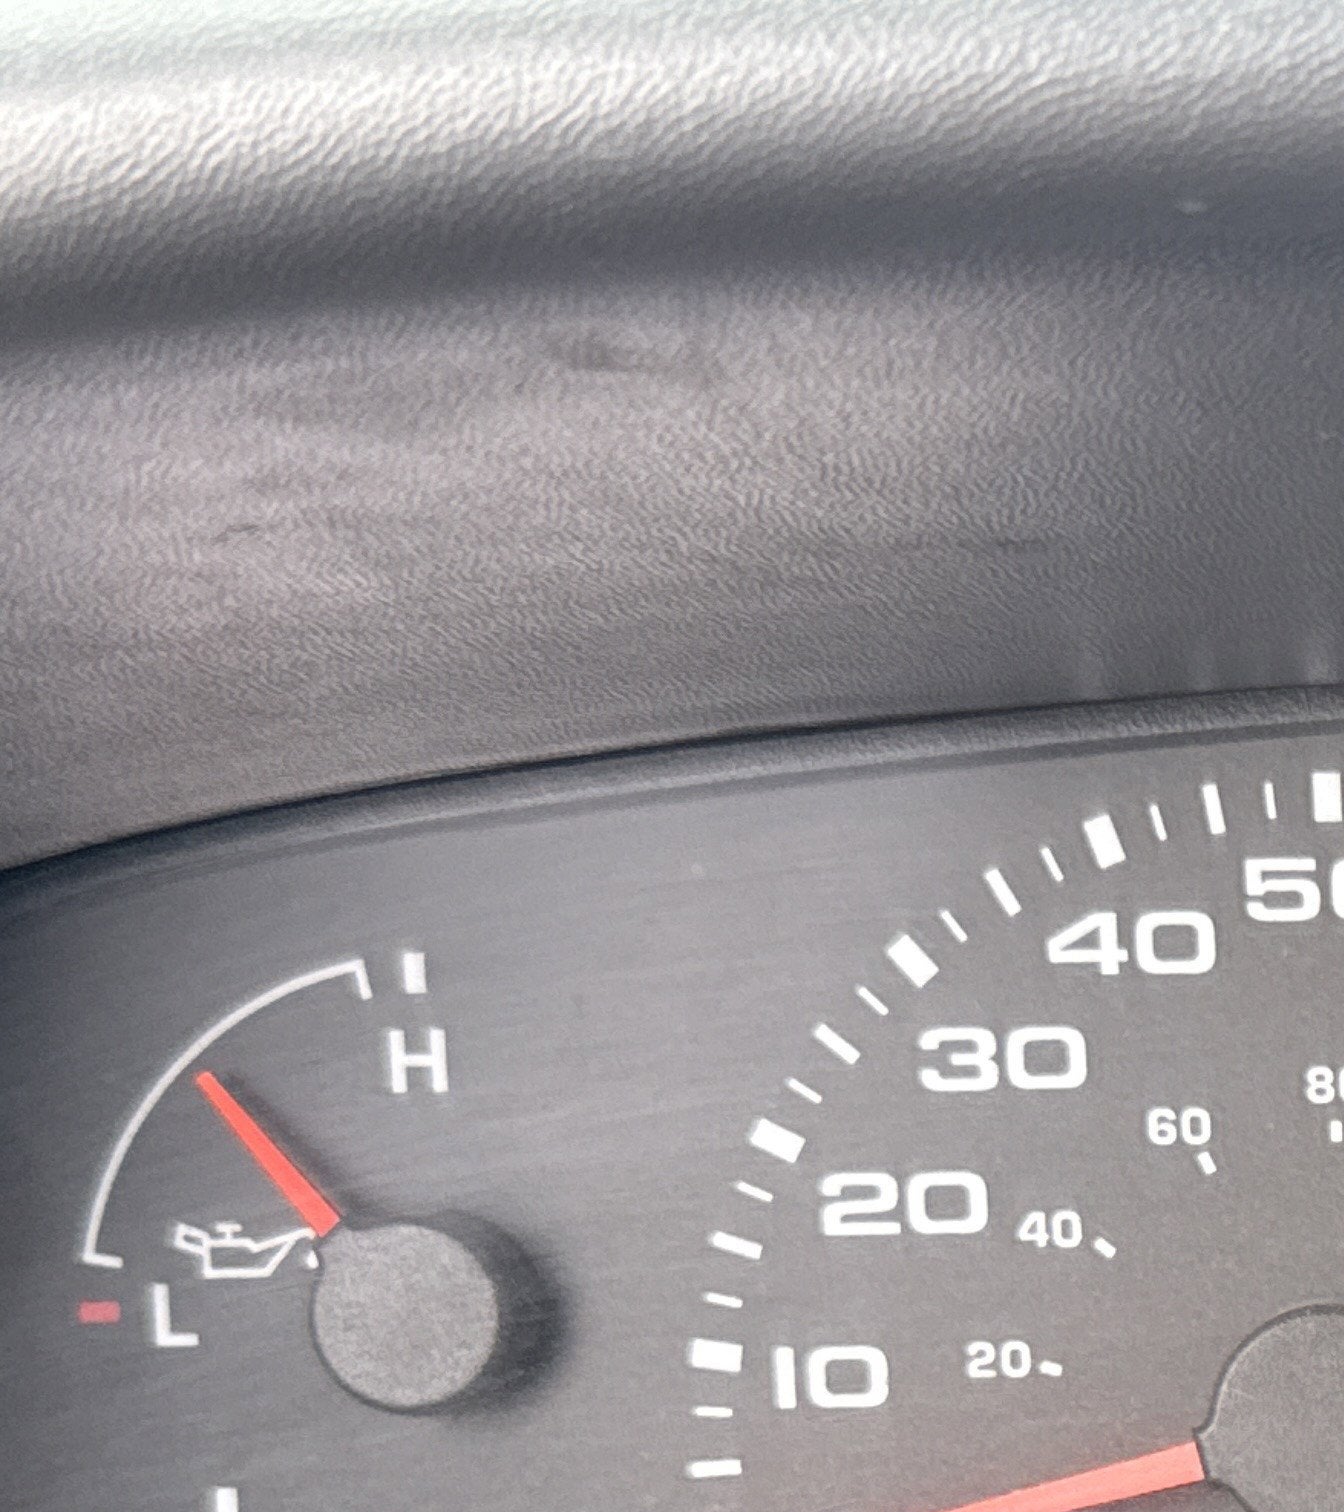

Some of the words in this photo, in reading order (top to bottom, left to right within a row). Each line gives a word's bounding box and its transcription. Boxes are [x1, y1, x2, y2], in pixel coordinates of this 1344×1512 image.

[1046, 910, 1216, 976] 40
[386, 1027, 449, 1094] H
[917, 1025, 1087, 1092] 30
[1147, 1106, 1212, 1146] 60
[818, 1170, 989, 1237] 20
[1016, 1209, 1083, 1249] 40
[151, 1283, 199, 1348] L
[772, 1344, 889, 1410] 10
[965, 1340, 1032, 1379] 20
